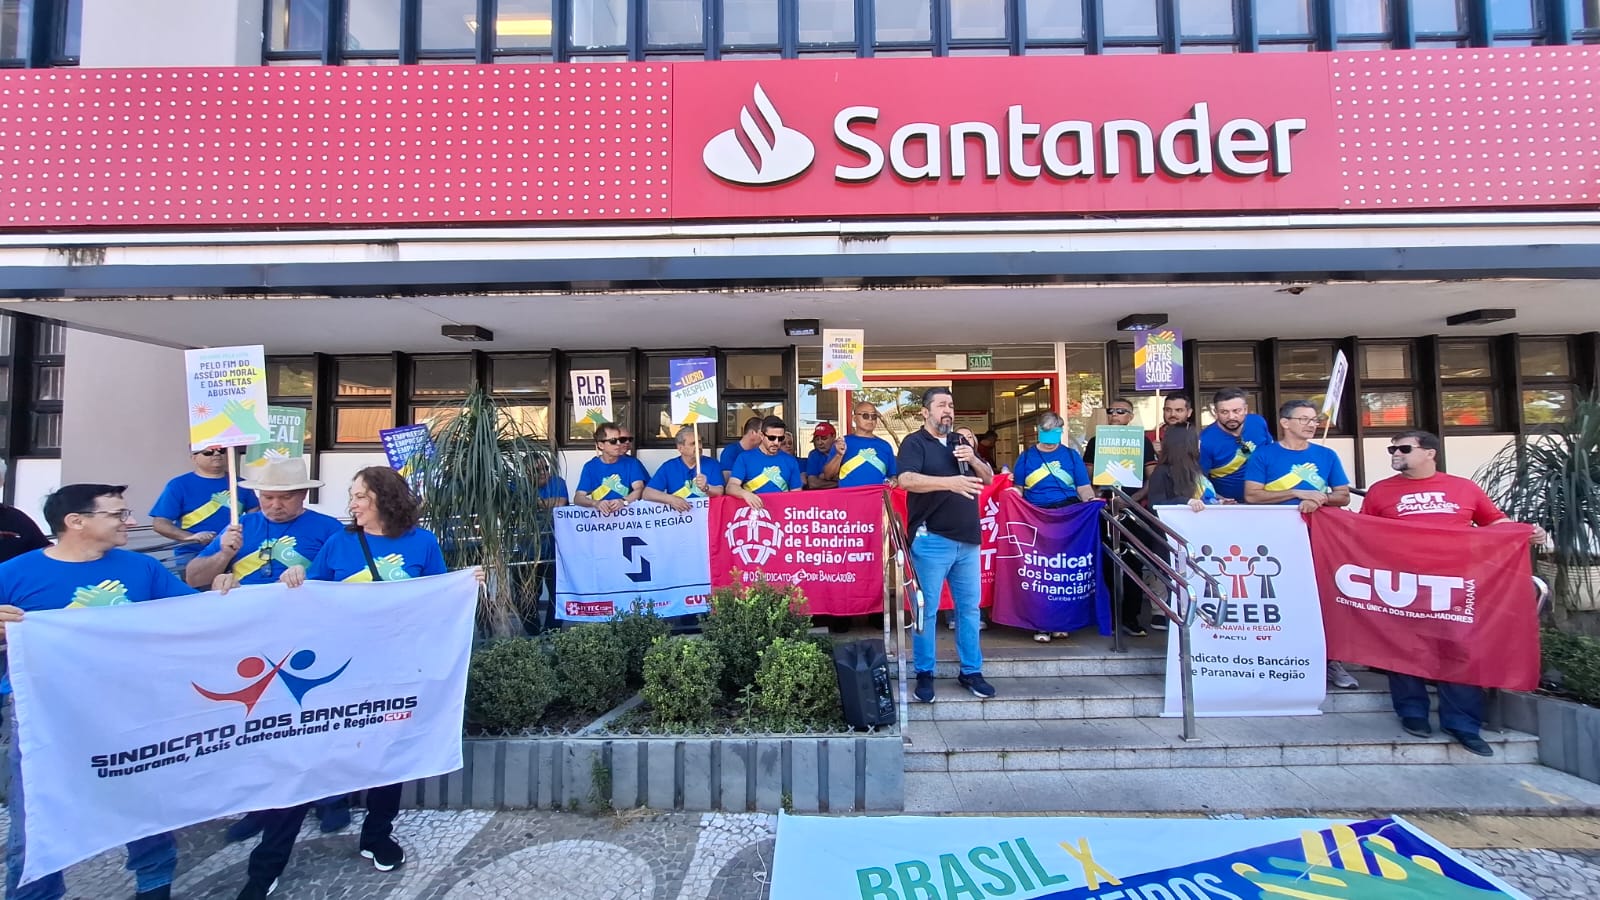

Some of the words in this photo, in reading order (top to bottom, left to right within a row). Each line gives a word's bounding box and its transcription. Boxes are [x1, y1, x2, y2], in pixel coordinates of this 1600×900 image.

[834, 101, 1307, 184] Santander
[1145, 343, 1172, 353] MENOS
[1146, 352, 1172, 361] METAS
[200, 361, 221, 370] PELO
[223, 360, 237, 369] FIM
[238, 359, 250, 368] DO
[1146, 361, 1173, 373] MAIS
[194, 369, 228, 380] ASSÉDIO
[229, 368, 257, 377] MORAL
[200, 381, 206, 389] E
[208, 379, 223, 388] DAS
[225, 378, 252, 387] METAS
[576, 376, 605, 395] PLR
[207, 387, 247, 397] ABUSIVAS
[578, 395, 607, 406] MAIOR
[267, 415, 301, 426] MENTO
[269, 424, 299, 443] EAL
[1098, 437, 1120, 447] LUTAR
[1121, 438, 1141, 447] PARA
[1401, 492, 1446, 504] CUT
[614, 508, 635, 517] DOS
[696, 500, 709, 508] DE
[784, 506, 847, 520] Sindicato
[576, 521, 642, 532] GUARAPUAVA
[645, 521, 651, 529] E
[654, 514, 693, 528] REGIÃO
[784, 521, 809, 534] dos
[811, 521, 875, 534] Bancários
[784, 535, 802, 548] de
[805, 535, 864, 548] Londrina
[785, 553, 793, 563] e
[1024, 550, 1094, 569] sindicat
[1018, 565, 1041, 578] dos
[1044, 567, 1094, 582] bancári
[1022, 582, 1029, 590] e
[1032, 579, 1095, 595] financiári
[1334, 563, 1464, 612] CUT
[1464, 579, 1475, 615] PARANÁ
[1200, 603, 1281, 623] SEEB
[1335, 596, 1366, 610] CENTRAL
[1366, 602, 1388, 613] ÚNICA
[1389, 608, 1405, 617] DOS
[1405, 612, 1473, 623] TRABALHADORES
[1183, 653, 1229, 663] ndicato
[1233, 655, 1254, 665] dos
[1257, 656, 1310, 666] Bancários
[1259, 671, 1265, 679] e
[1269, 670, 1305, 681] Região
[91, 724, 236, 768] SINDICATO
[245, 713, 292, 734] DOS
[300, 695, 418, 724] BANCÁRIOS
[97, 753, 191, 778] Umuarama,
[195, 739, 231, 758] Assis
[235, 720, 330, 747] Chateaubriand
[333, 722, 341, 731] e
[344, 713, 384, 729] Região
[385, 711, 410, 721] CUT
[855, 837, 1070, 900] BRASIL
[1059, 837, 1123, 891] X
